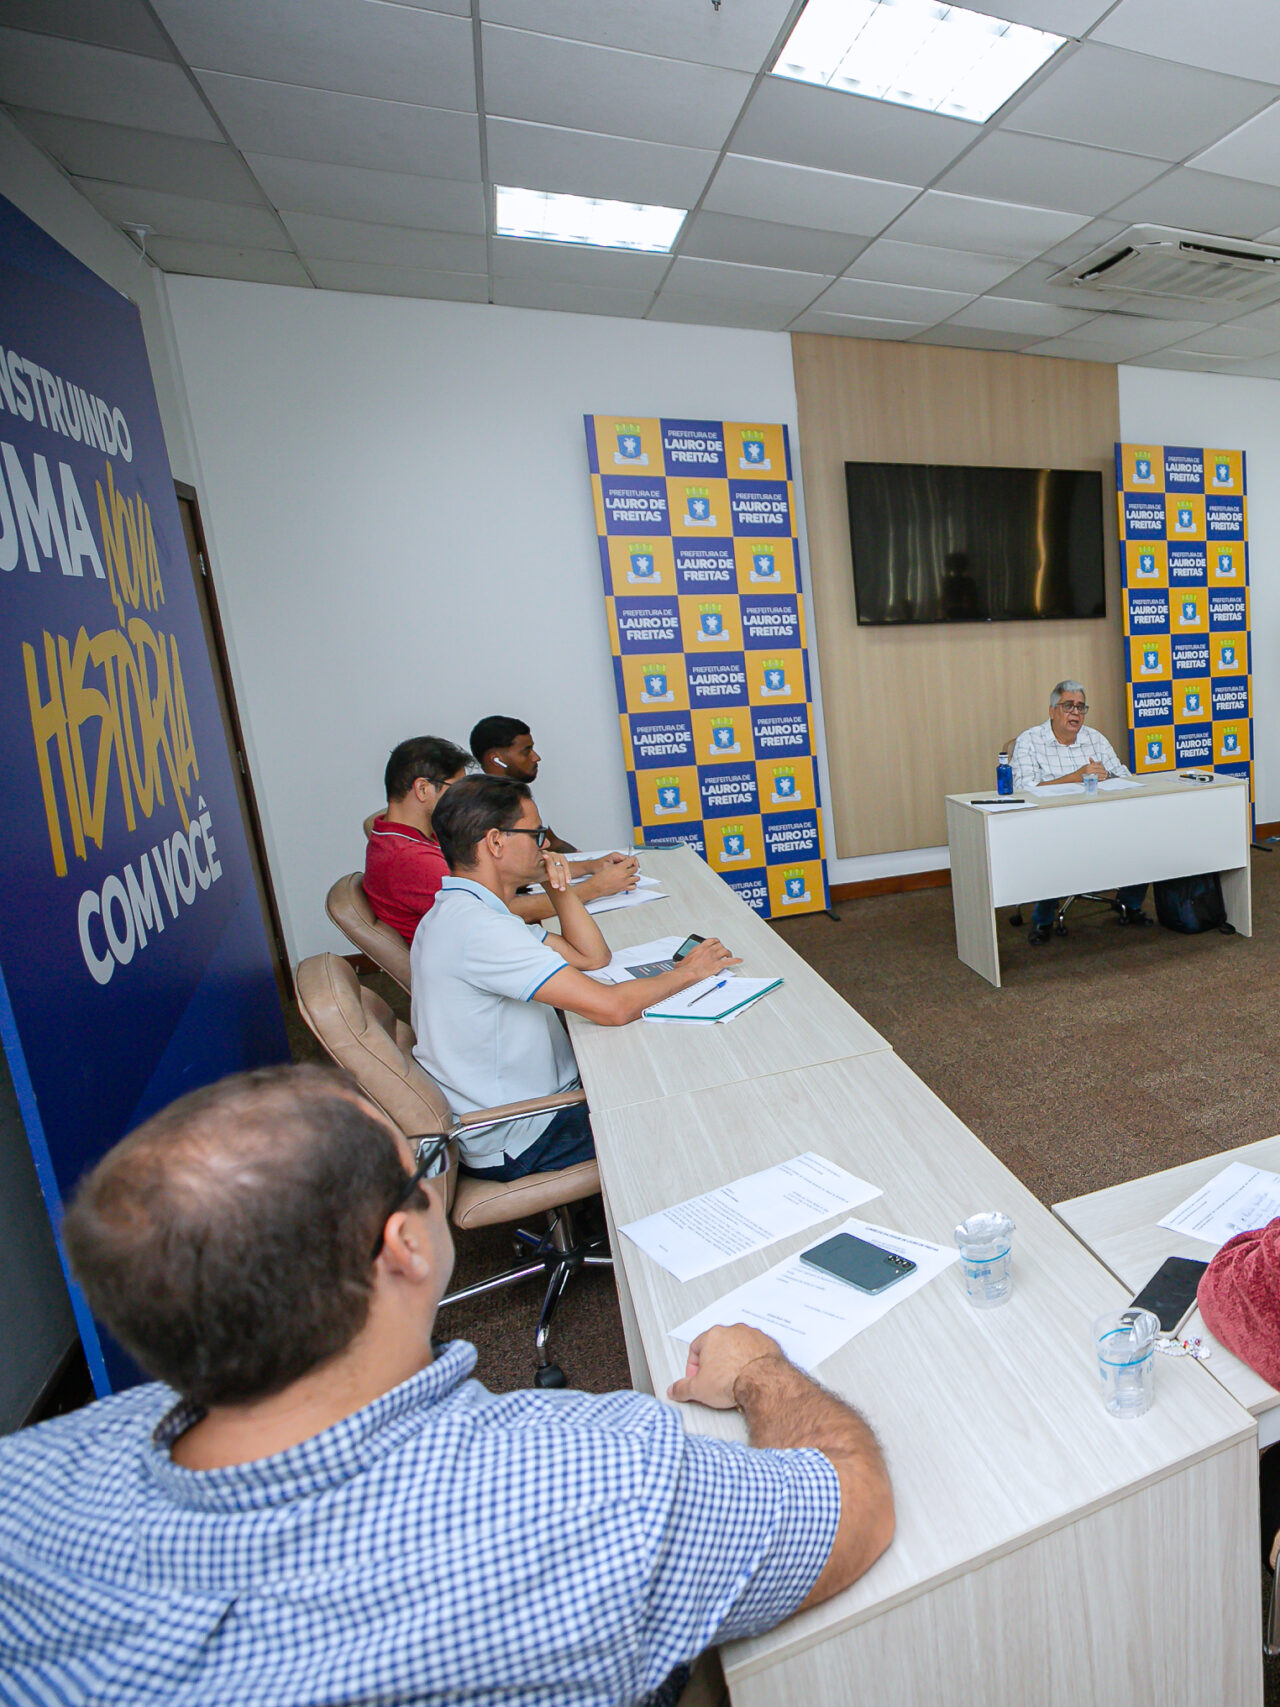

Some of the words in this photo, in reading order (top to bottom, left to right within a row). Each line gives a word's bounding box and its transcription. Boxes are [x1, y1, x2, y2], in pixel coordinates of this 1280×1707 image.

[663, 438, 705, 450] LAURO
[706, 440, 722, 451] DE
[670, 450, 718, 462] FREITAS
[1165, 462, 1191, 472] LAURO
[1192, 464, 1202, 472] DE
[1169, 472, 1199, 482] FREITAS
[605, 498, 648, 509] LAURO
[649, 498, 666, 509] DE
[731, 500, 771, 511] LAURO
[772, 502, 787, 511] DE
[612, 510, 662, 521] FREITAS
[738, 512, 783, 523] FREITAS
[1126, 510, 1153, 519] LAURO
[1154, 510, 1164, 519] DE
[1207, 512, 1232, 521] LAURO
[1232, 512, 1242, 521] DE
[1130, 520, 1161, 529] FREITAS
[1210, 521, 1239, 530] FREITAS
[95, 459, 165, 612] NOVA
[676, 558, 717, 568] LAURO
[717, 558, 733, 568] DE
[1169, 558, 1195, 567] LAURO
[1195, 558, 1206, 566] DE
[683, 570, 729, 580] FREITAS
[1173, 567, 1203, 576] FREITAS
[1130, 605, 1157, 614] LAURO
[1157, 605, 1168, 613] DE
[1210, 603, 1234, 612] LAURO
[1235, 603, 1245, 611] DE
[742, 614, 781, 625] LAURO
[782, 614, 797, 624] DE
[1134, 614, 1165, 623] FREITAS
[1213, 612, 1242, 621] FREITAS
[618, 617, 661, 628] LAURO
[661, 617, 678, 627] DE
[626, 629, 674, 640] FREITAS
[749, 625, 793, 636] FREITAS
[1172, 650, 1198, 660] LAURO
[1199, 650, 1208, 658] DE
[692, 665, 729, 673] PREFEITURA
[1176, 659, 1206, 669] FREITAS
[688, 673, 728, 684] LAURO
[729, 672, 745, 682] DE
[695, 684, 741, 695] FREITAS
[1212, 692, 1237, 701] LAURO
[1237, 691, 1247, 700] DE
[1134, 698, 1161, 708] LAURO
[1161, 697, 1171, 706] DE
[1216, 700, 1244, 710] FREITAS
[1138, 706, 1168, 717] FREITAS
[757, 716, 792, 724] PREFEITURA
[636, 724, 675, 733] PREFEITURA
[753, 724, 791, 736] LAURO
[792, 723, 807, 733] DE
[633, 732, 674, 745] LAURO
[674, 731, 691, 742] DE
[760, 734, 803, 746] FREITAS
[1176, 739, 1201, 749] LAURO
[1202, 738, 1211, 746] DE
[640, 743, 687, 756] FREITAS
[1180, 747, 1208, 758] FREITAS
[704, 775, 741, 784] PREFEITURA
[701, 782, 740, 795] LAURO
[740, 781, 756, 791] DE
[707, 792, 752, 806] FREITAS
[768, 822, 803, 831] PREFEITURA
[765, 830, 802, 843] LAURO
[802, 828, 817, 838] DE
[771, 839, 813, 853] FREITAS
[78, 853, 165, 985] COM
[152, 795, 222, 918] VOCÊ
[752, 887, 767, 898] DE
